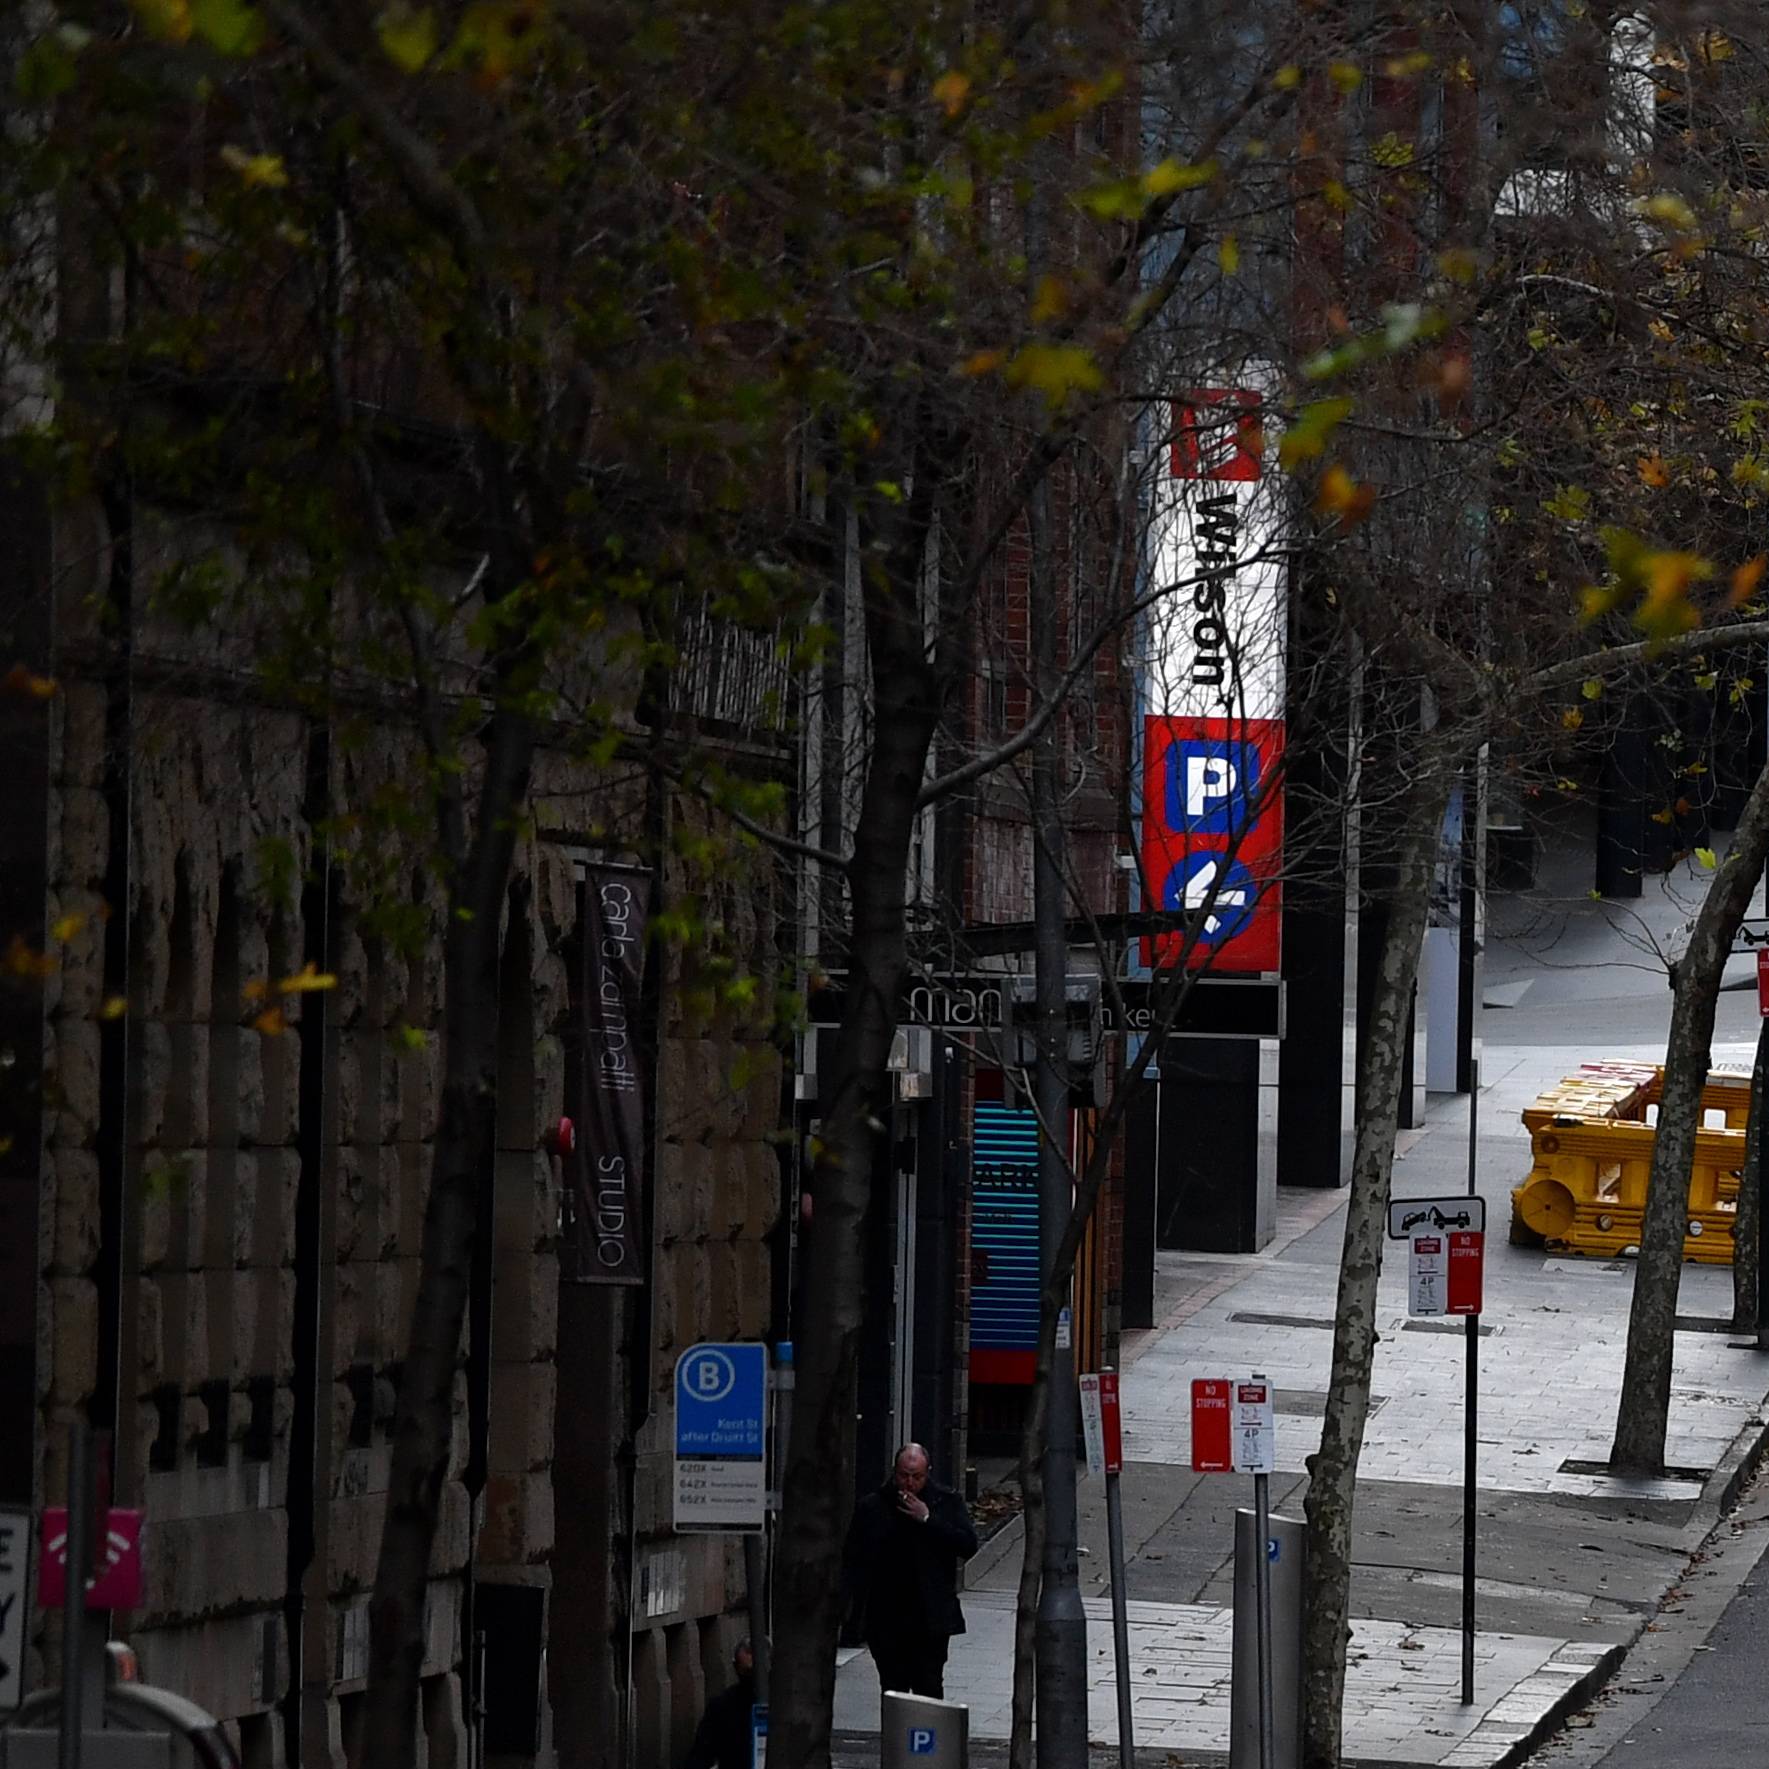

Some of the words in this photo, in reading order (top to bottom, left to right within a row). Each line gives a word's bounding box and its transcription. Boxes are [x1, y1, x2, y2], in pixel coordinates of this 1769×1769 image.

[1193, 493, 1237, 686] Wilson
[1187, 756, 1237, 816] P
[598, 1155, 625, 1267] STUDIO
[1460, 1237, 1471, 1245] NO
[1452, 1248, 1479, 1256] STOPPING
[1420, 1277, 1434, 1285] 4P
[699, 1362, 719, 1390] B
[1205, 1386, 1216, 1394] NO
[1196, 1398, 1226, 1408] STOPPING
[680, 1431, 709, 1441] after
[1244, 1429, 1259, 1438] 4P
[914, 1731, 930, 1751] P
